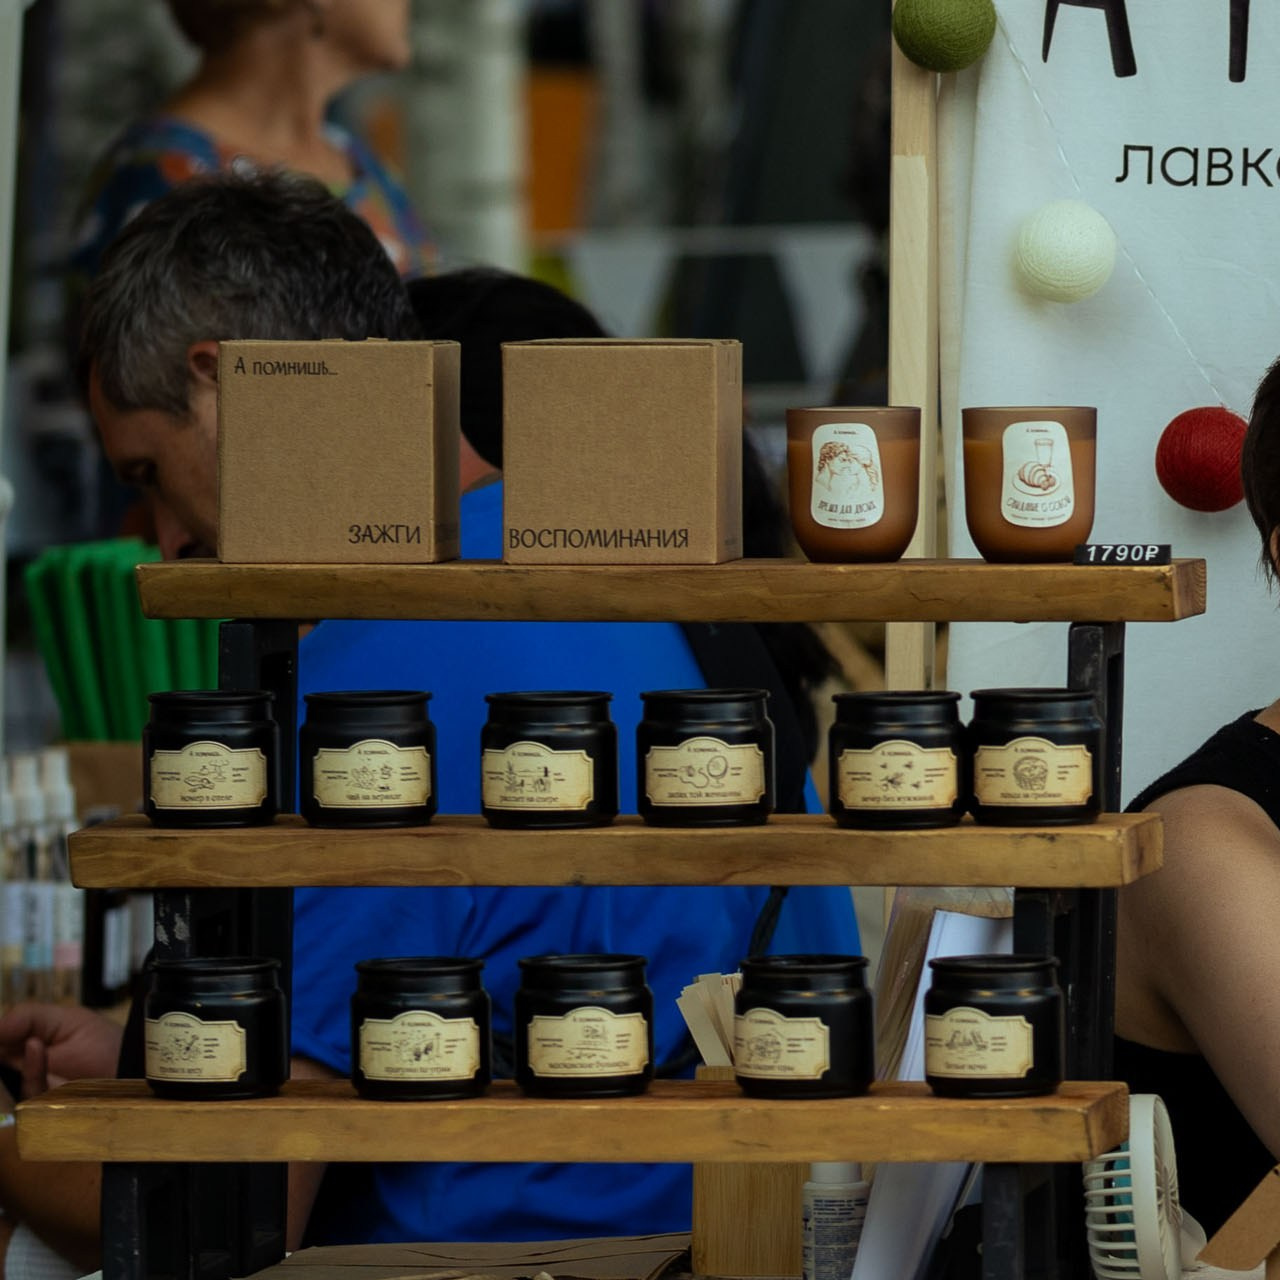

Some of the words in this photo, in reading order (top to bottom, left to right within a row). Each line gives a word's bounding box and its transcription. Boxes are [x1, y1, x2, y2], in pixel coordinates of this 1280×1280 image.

[234, 356, 247, 376] А
[347, 524, 422, 545] ЗАЖГИ
[508, 528, 689, 549] ВОСПОМИНАНИЯ
